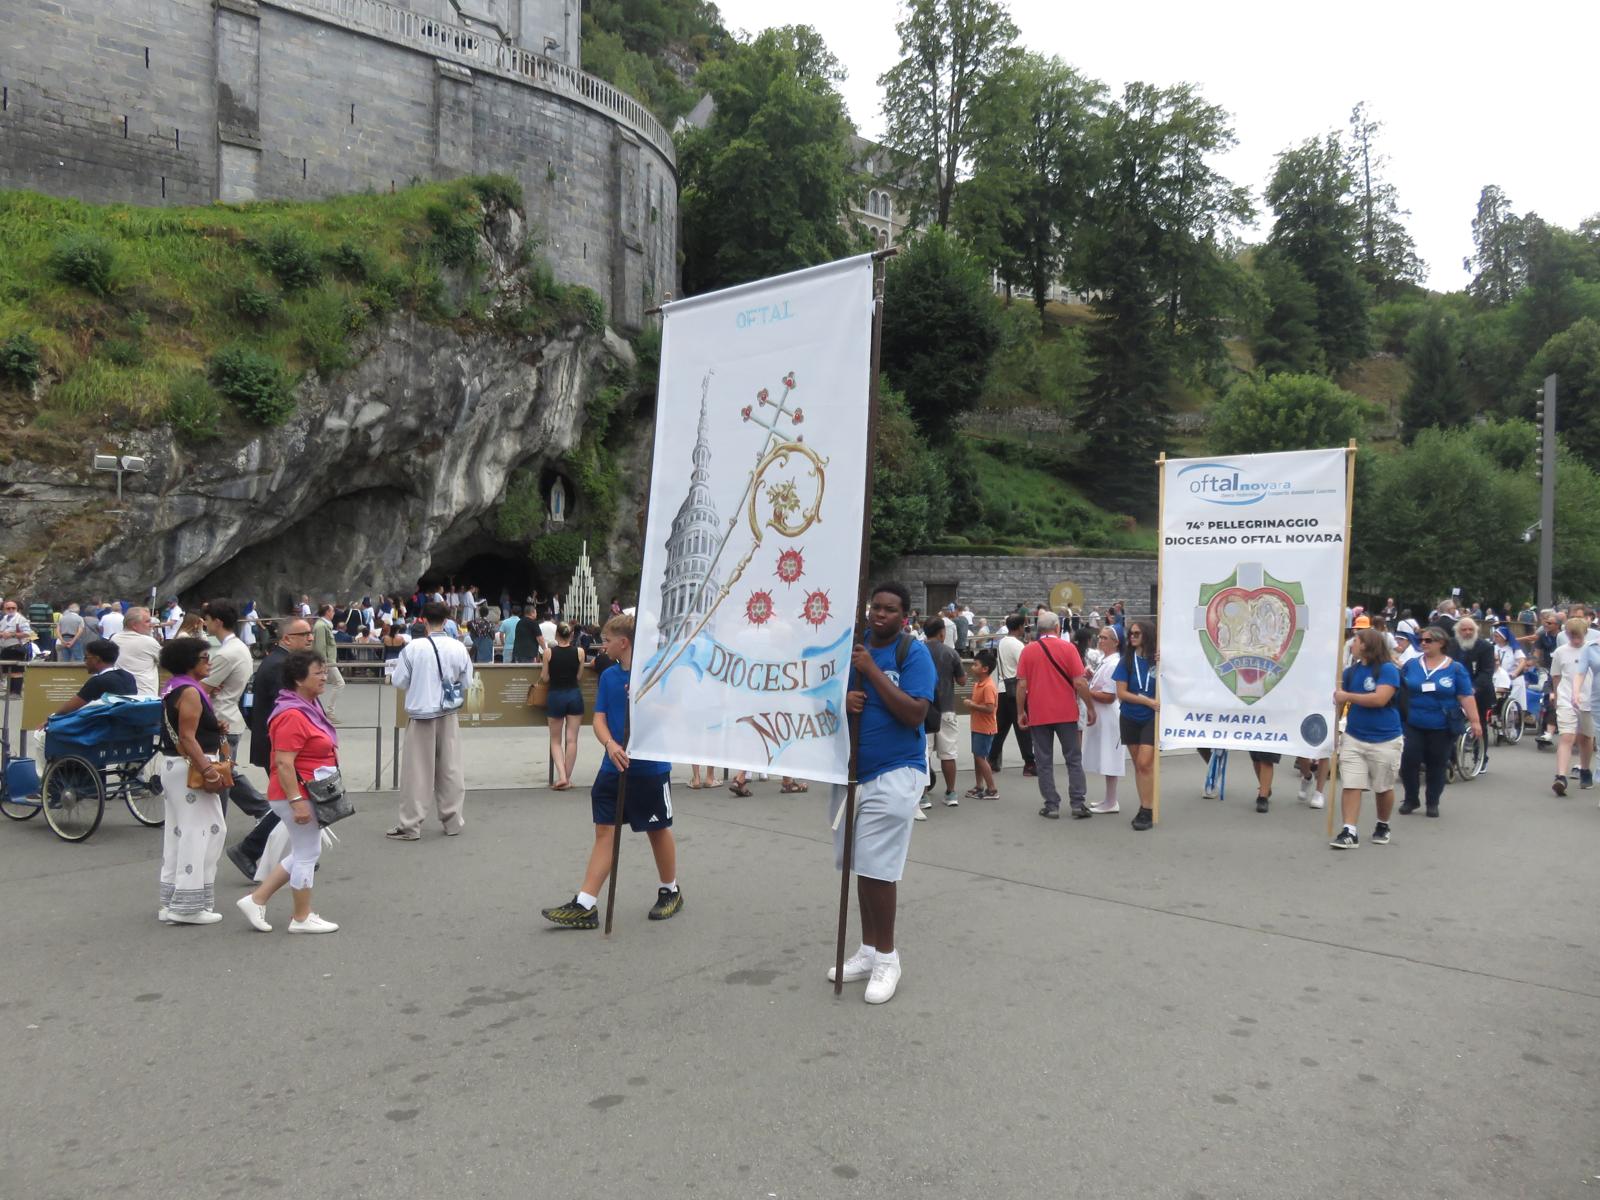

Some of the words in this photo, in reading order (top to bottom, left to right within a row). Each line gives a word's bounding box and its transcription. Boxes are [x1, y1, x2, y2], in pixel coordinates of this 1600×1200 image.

[736, 300, 795, 329] OFTAL
[1208, 518, 1319, 530] PELLEGRINAGGIO
[1164, 535, 1238, 546] DIOCESANO
[1241, 534, 1282, 545] OFTAL
[1285, 533, 1343, 544] NOVARA
[707, 644, 808, 691] DIOCESI
[819, 658, 837, 682] DI
[1184, 712, 1213, 722] AVE
[1219, 713, 1267, 725] MARIA
[1164, 728, 1206, 739] PIENA
[1212, 729, 1228, 740] DI
[1234, 730, 1289, 742] GRAZIA
